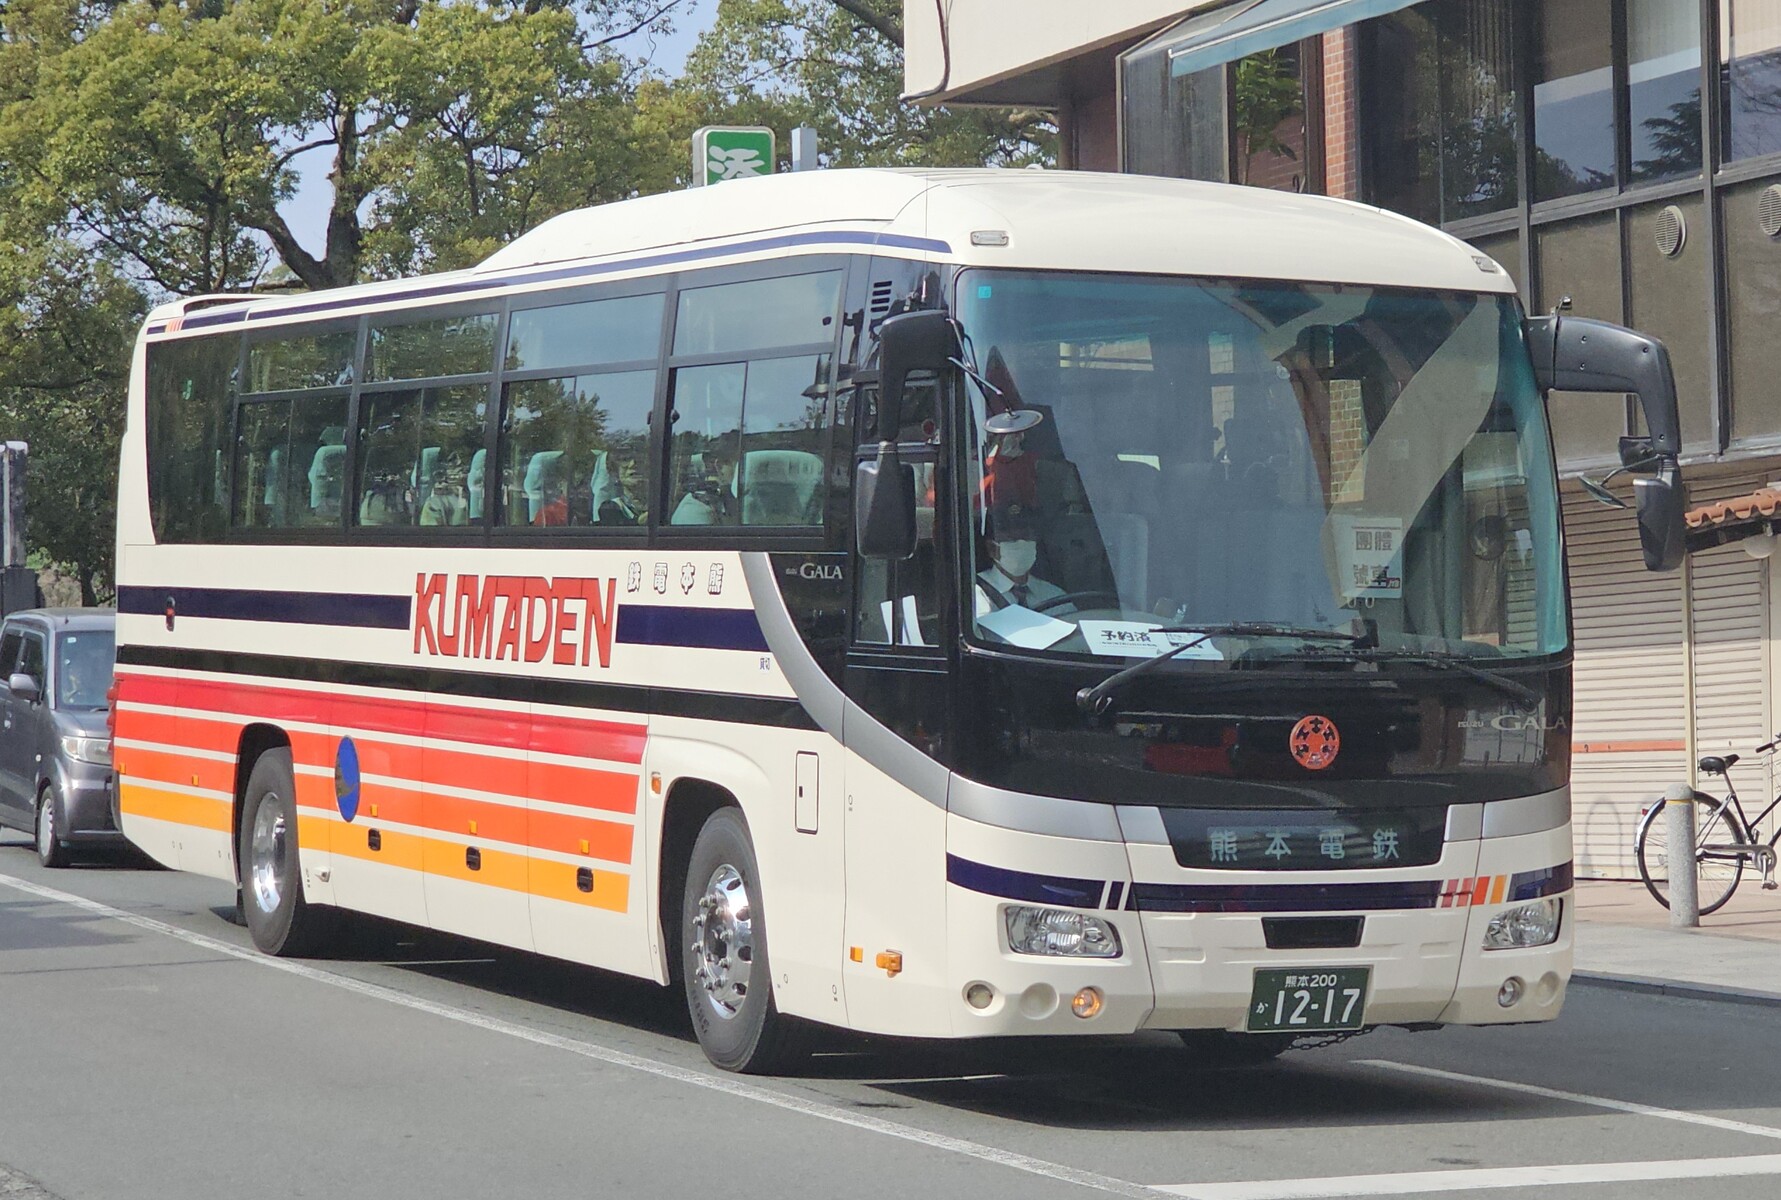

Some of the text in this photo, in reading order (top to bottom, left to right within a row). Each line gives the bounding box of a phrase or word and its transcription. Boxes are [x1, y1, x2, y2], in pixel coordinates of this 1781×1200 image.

[800, 562, 843, 580] GALA
[413, 572, 617, 668] KUMADEN
[1490, 714, 1567, 730] GALA
[1210, 828, 1400, 862] 熊本電鉄
[1255, 988, 1361, 1025] か 12-17
